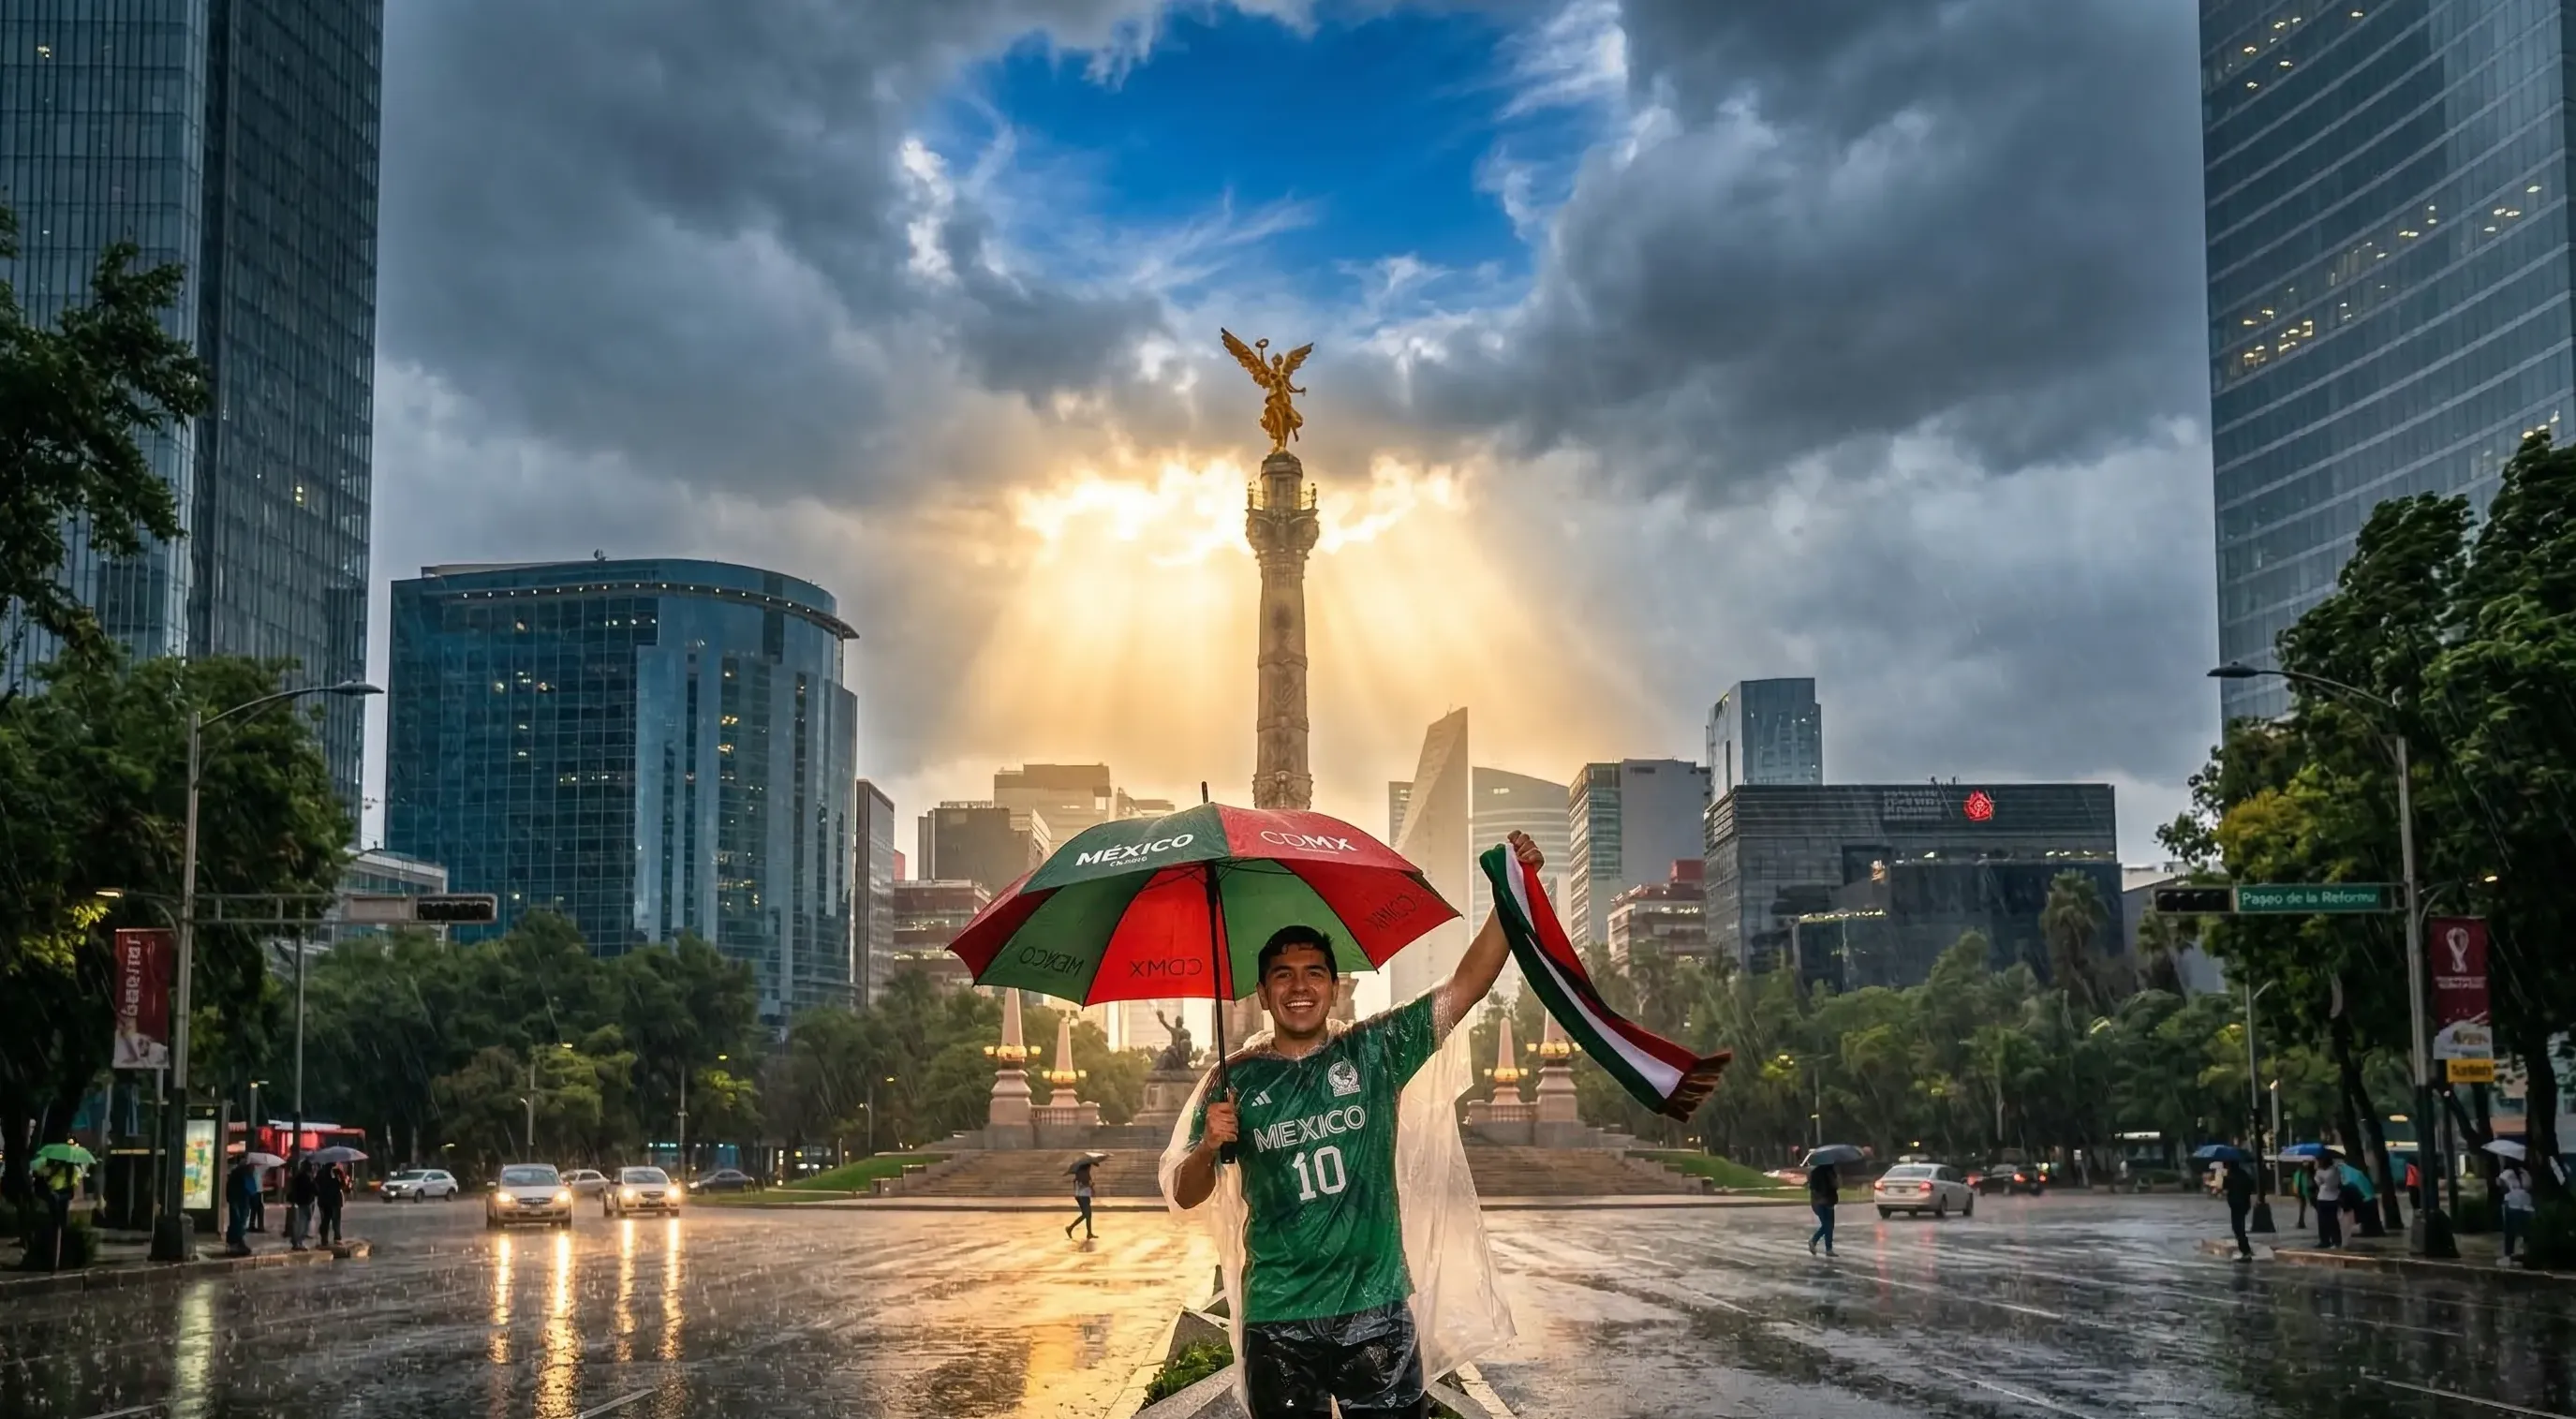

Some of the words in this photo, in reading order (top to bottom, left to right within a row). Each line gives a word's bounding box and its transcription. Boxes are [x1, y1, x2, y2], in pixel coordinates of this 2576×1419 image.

[1075, 834, 1194, 866] MÉXICO
[1260, 831, 1358, 851] CDMX
[2242, 892, 2283, 907] Paseo
[2287, 892, 2302, 905] de
[2305, 891, 2318, 904] la
[1253, 1104, 1366, 1153] MEXICO
[1292, 1145, 1347, 1201] 10
